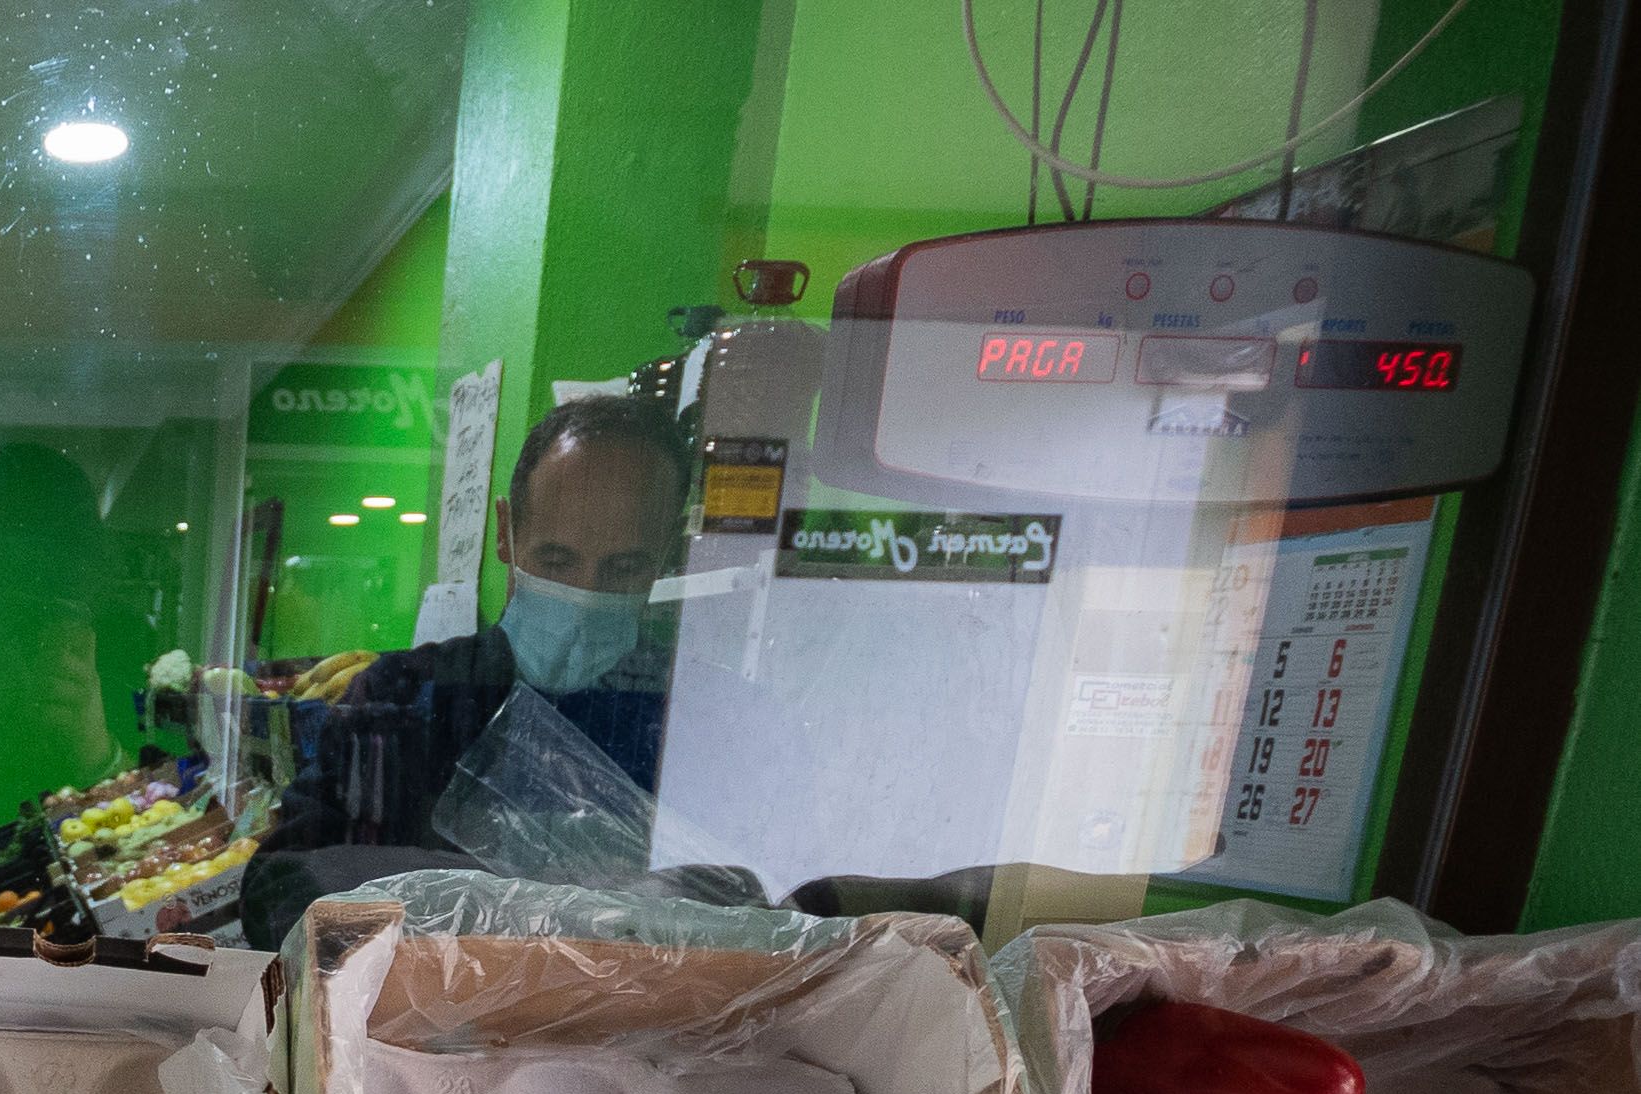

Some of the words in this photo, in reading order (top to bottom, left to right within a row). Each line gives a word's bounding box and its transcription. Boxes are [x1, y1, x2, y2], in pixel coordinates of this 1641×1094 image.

[979, 339, 1086, 378] PAGA
[1273, 640, 1292, 679] 5
[1328, 638, 1347, 679] 6
[1259, 688, 1285, 727] 12
[1313, 688, 1343, 728] 13
[1248, 736, 1276, 774] 19
[1299, 738, 1331, 777] 20
[1237, 784, 1266, 821] 26
[1288, 786, 1321, 825] 27
